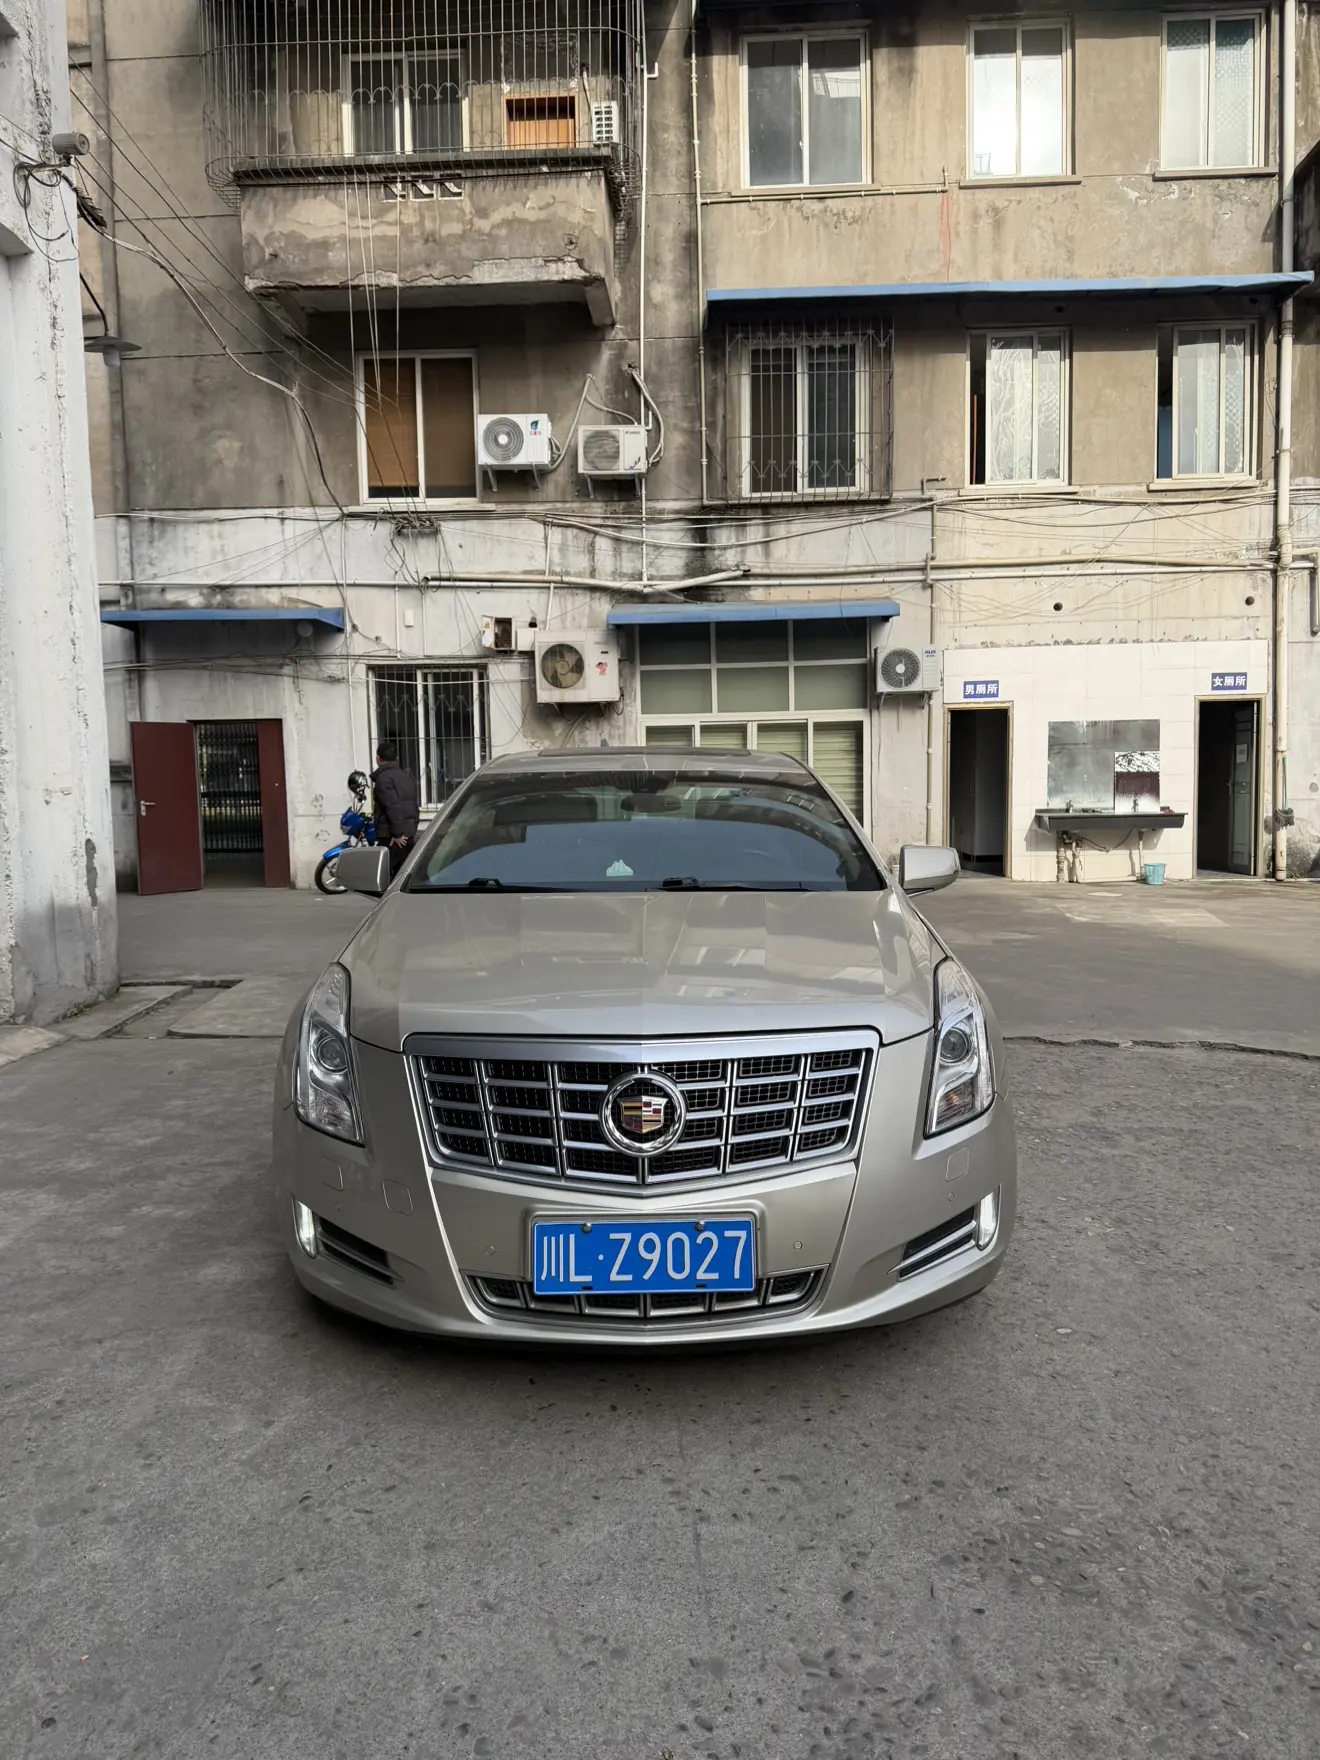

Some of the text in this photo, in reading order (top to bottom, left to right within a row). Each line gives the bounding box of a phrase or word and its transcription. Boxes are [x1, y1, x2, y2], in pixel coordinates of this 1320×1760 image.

[1212, 675, 1247, 687] 女厕所
[964, 683, 998, 695] 男厕所
[540, 1230, 747, 1282] 川L·Z9027
